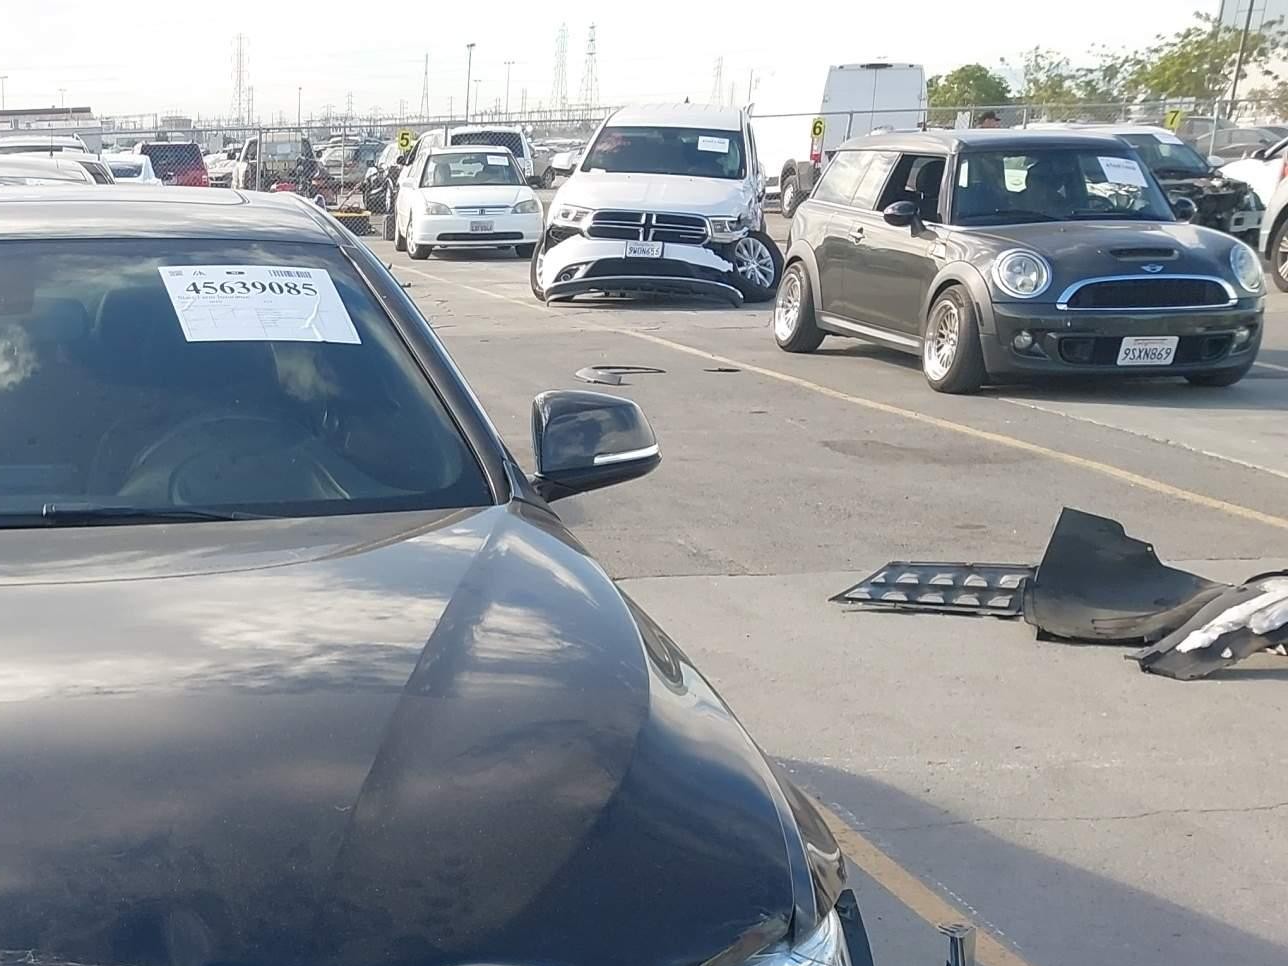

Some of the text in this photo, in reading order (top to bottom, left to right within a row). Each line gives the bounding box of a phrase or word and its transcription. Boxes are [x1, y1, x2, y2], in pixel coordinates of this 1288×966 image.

[1169, 110, 1180, 125] 7
[813, 120, 823, 136] 6
[400, 132, 410, 147] 5
[186, 281, 318, 296] 45639085
[1121, 347, 1172, 361] 9SXN869
